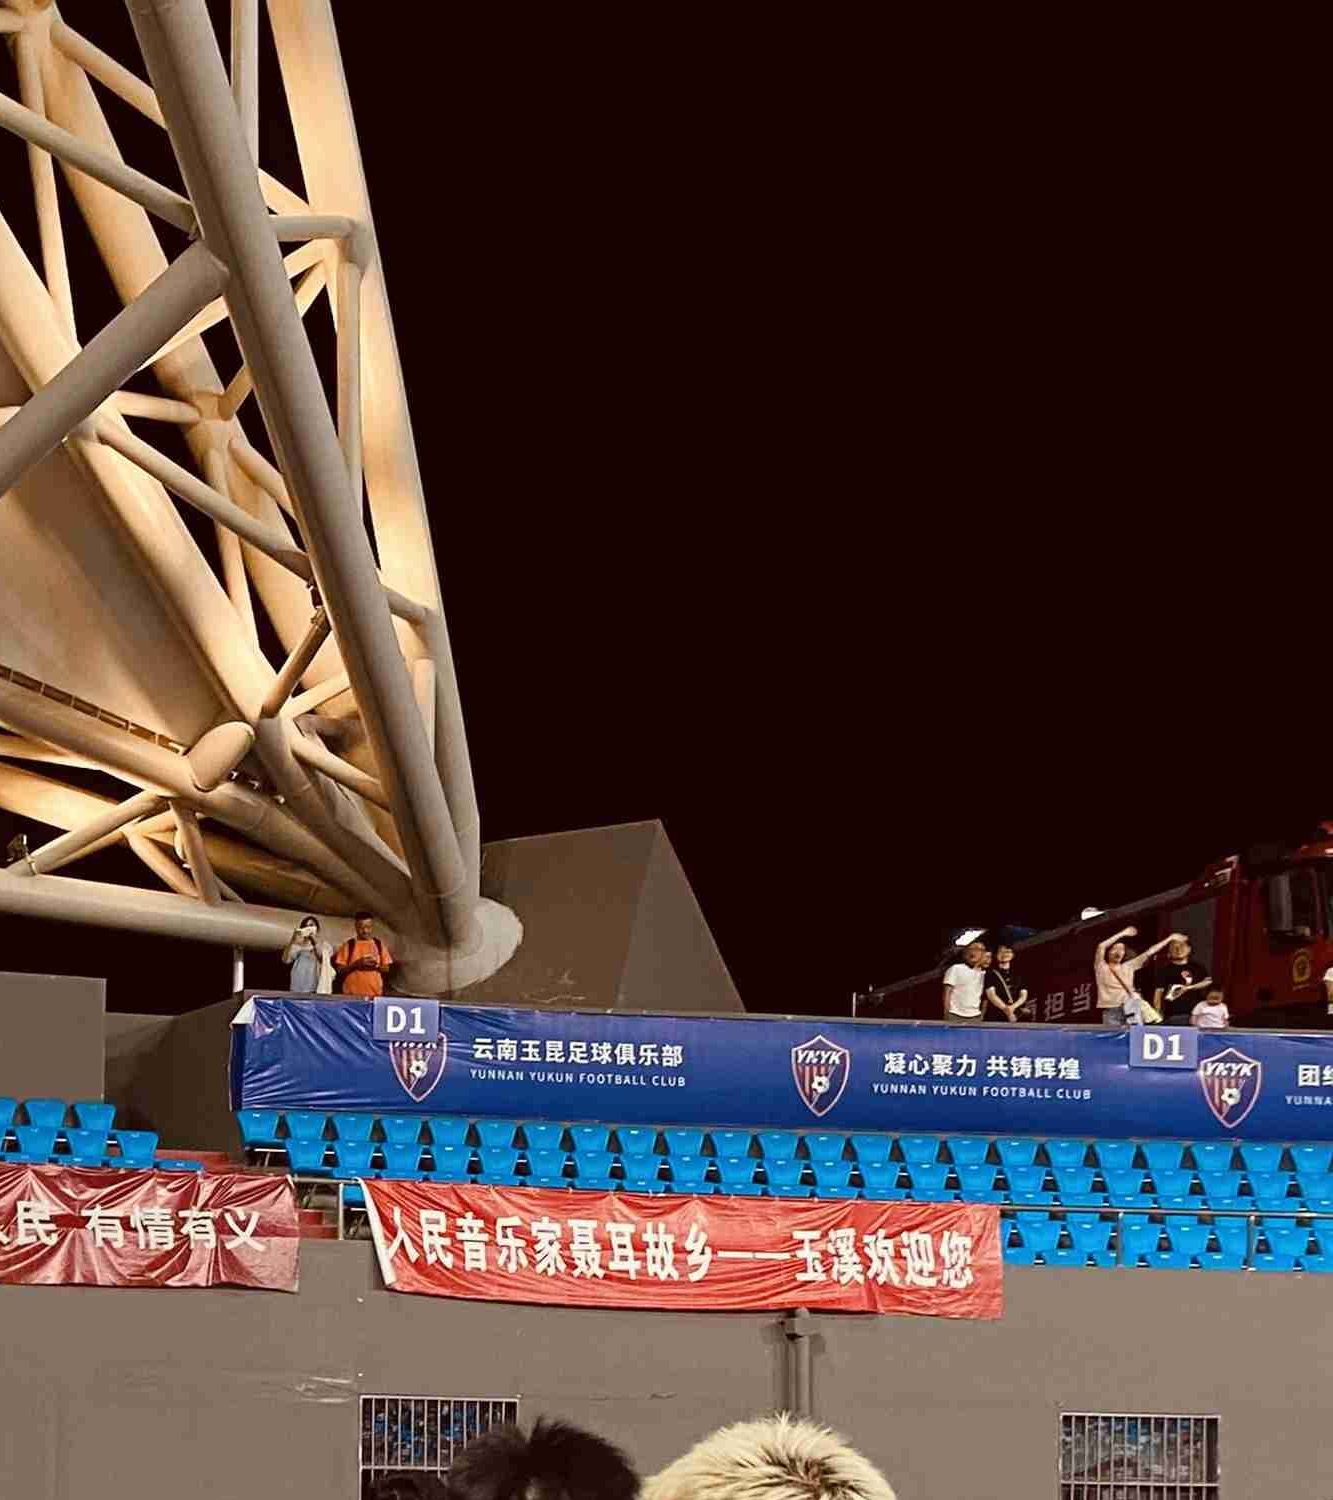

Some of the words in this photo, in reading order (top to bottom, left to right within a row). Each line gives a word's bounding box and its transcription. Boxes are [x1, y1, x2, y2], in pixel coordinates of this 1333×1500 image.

[386, 1005, 426, 1035] D1
[472, 1037, 684, 1068] 云南玉昆足球俱乐部
[1142, 1033, 1185, 1061] D1
[470, 1068, 524, 1081] YUNNAN
[529, 1071, 574, 1083] YUKUN
[579, 1072, 646, 1086] FOOTBALL
[652, 1075, 686, 1087] CLUB
[884, 1052, 977, 1077] 凝心聚力
[986, 1055, 1082, 1081] 共铸辉煌
[872, 1082, 927, 1095] YUNNAN
[932, 1084, 977, 1096] YUKUN
[983, 1085, 1052, 1098] FOOTBALL
[1056, 1087, 1092, 1100] CLUB
[80, 1204, 267, 1252] 有情有义
